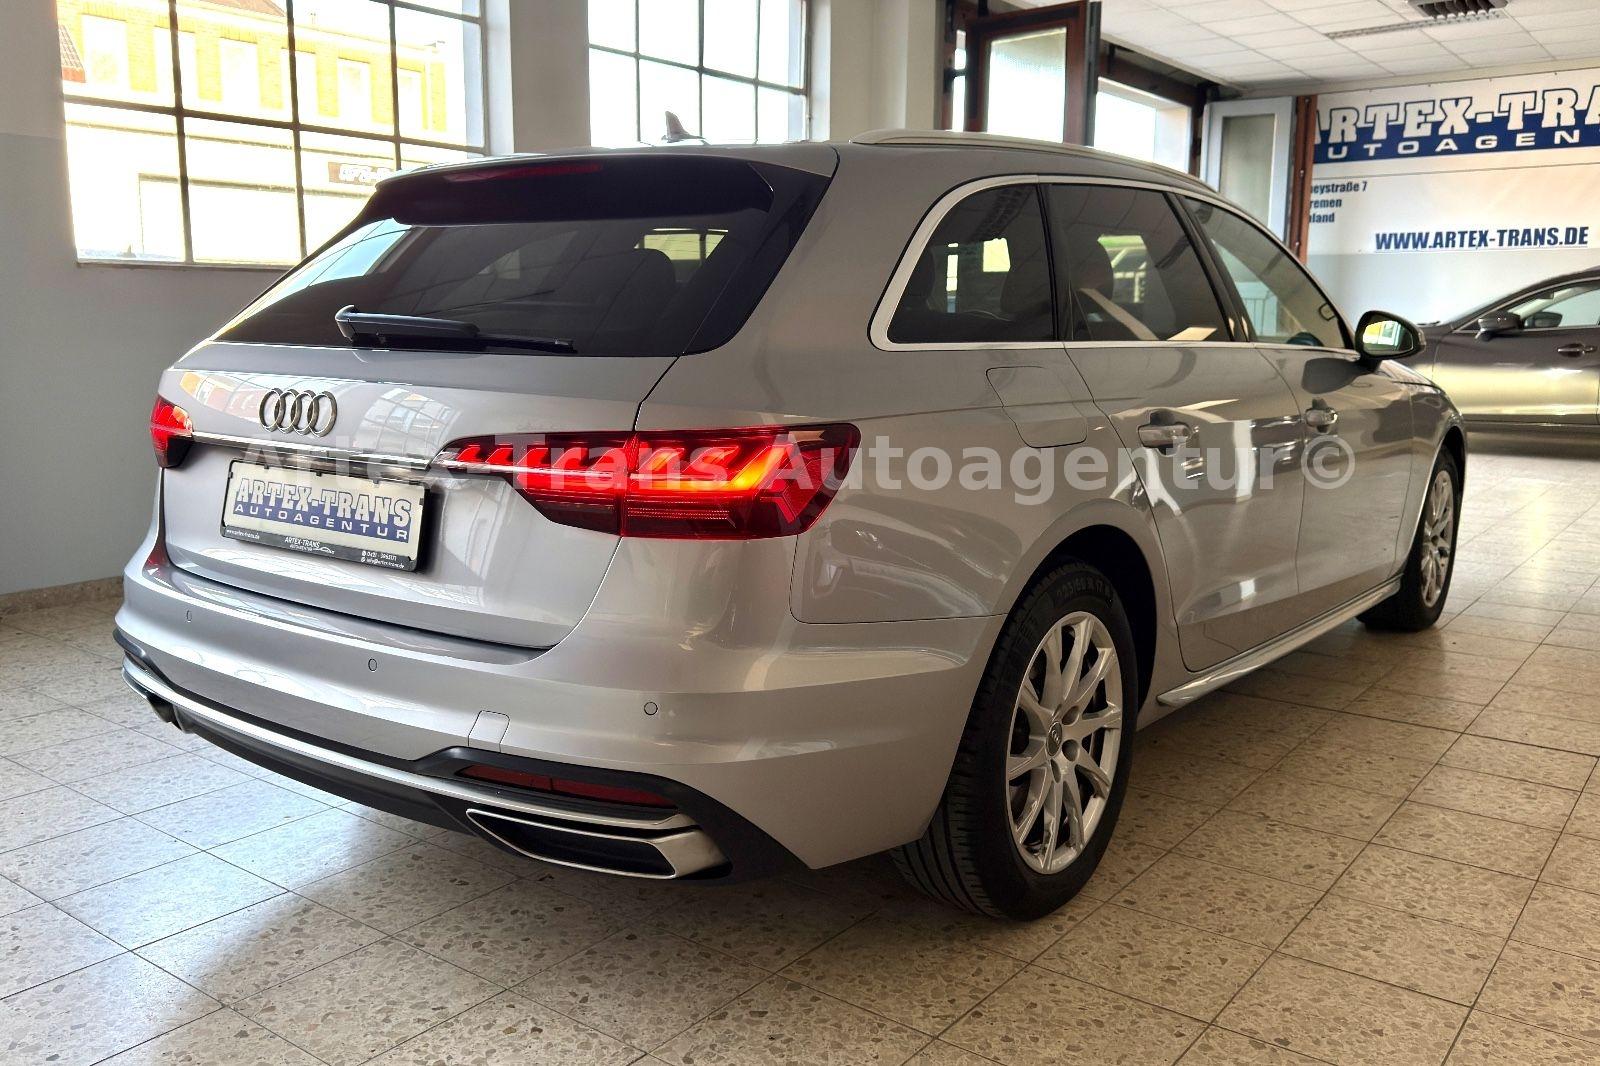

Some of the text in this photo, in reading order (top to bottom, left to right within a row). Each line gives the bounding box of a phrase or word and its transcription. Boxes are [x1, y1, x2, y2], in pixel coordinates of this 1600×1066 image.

[1311, 180, 1368, 195] eystraße 7
[1309, 212, 1335, 223] land
[1375, 226, 1589, 251] WWW.ARTEX-TRANS.DE
[236, 477, 412, 528] ARTEX-TRANS
[234, 504, 409, 540] AUTOAGENTUR
[284, 536, 321, 549] ARTEX-TRANS
